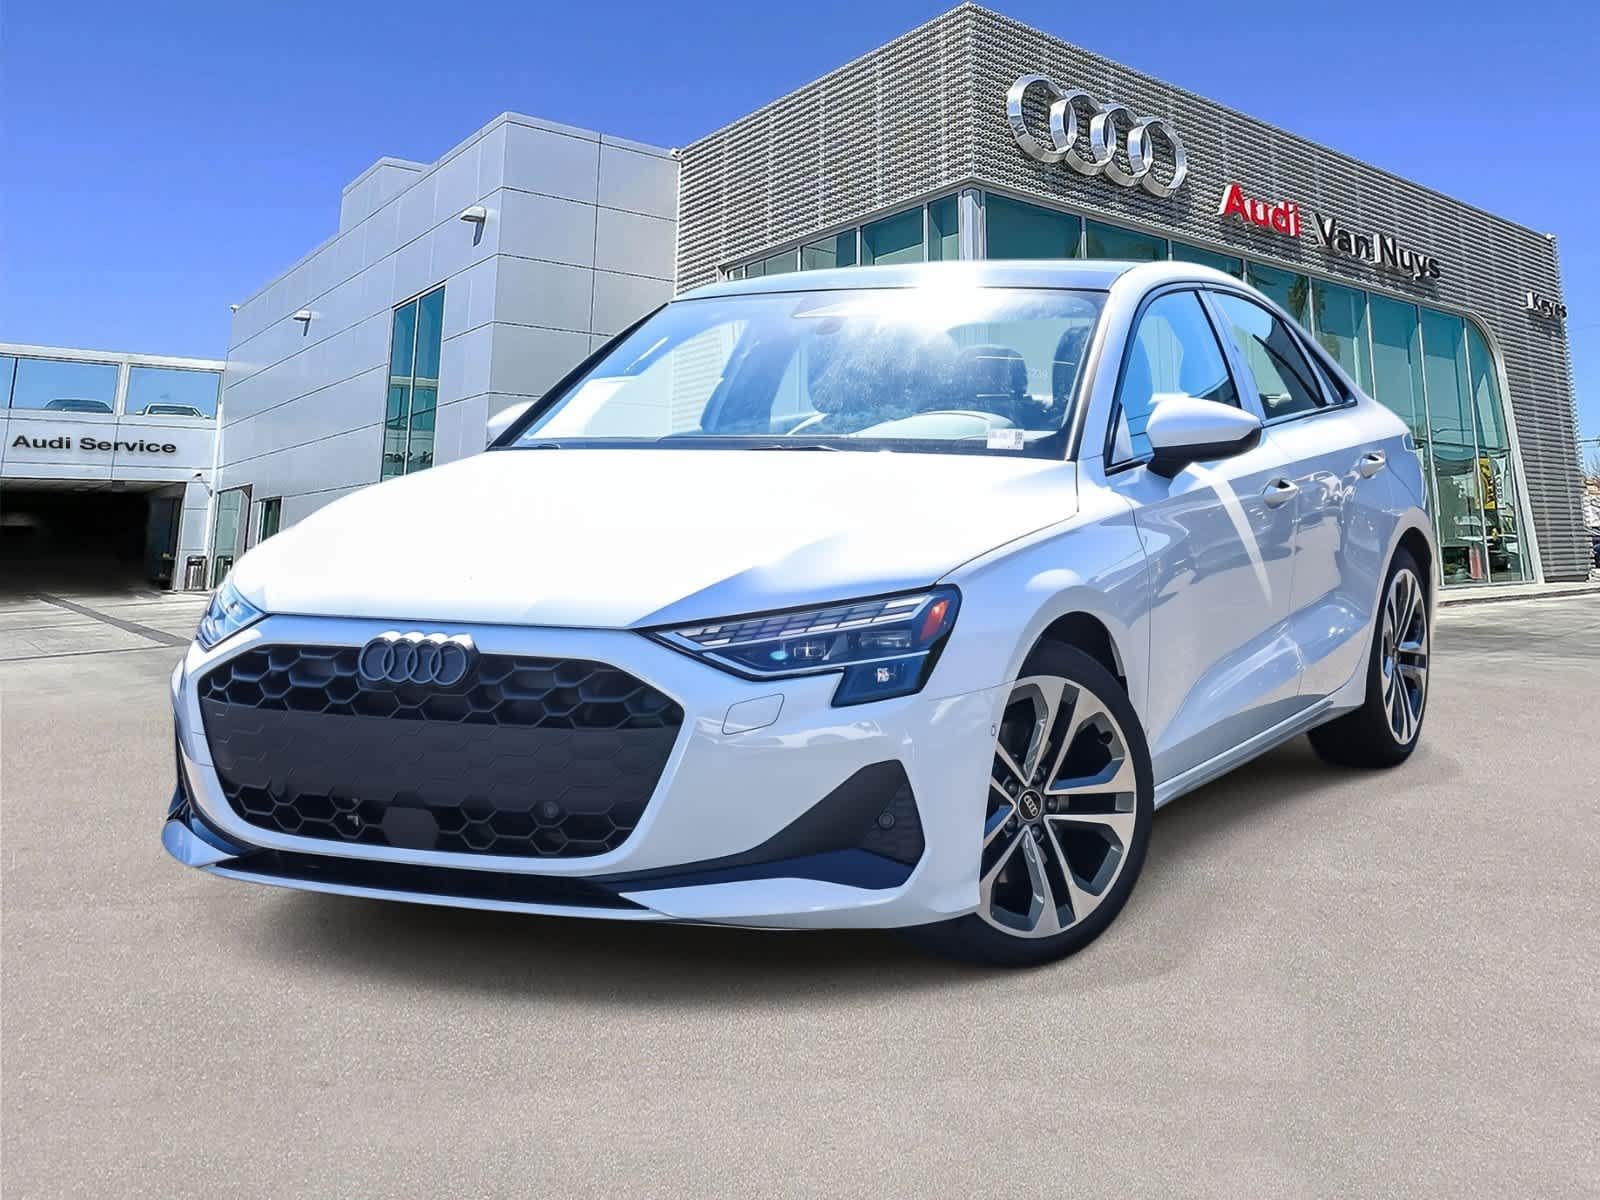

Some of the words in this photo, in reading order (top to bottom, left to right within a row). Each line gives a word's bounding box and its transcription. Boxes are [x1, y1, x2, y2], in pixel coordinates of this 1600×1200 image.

[1218, 182, 1302, 238] Audi
[1311, 213, 1370, 259] Van
[1373, 233, 1440, 280] Nuys
[12, 435, 71, 449] Audi
[79, 437, 177, 453] Service
